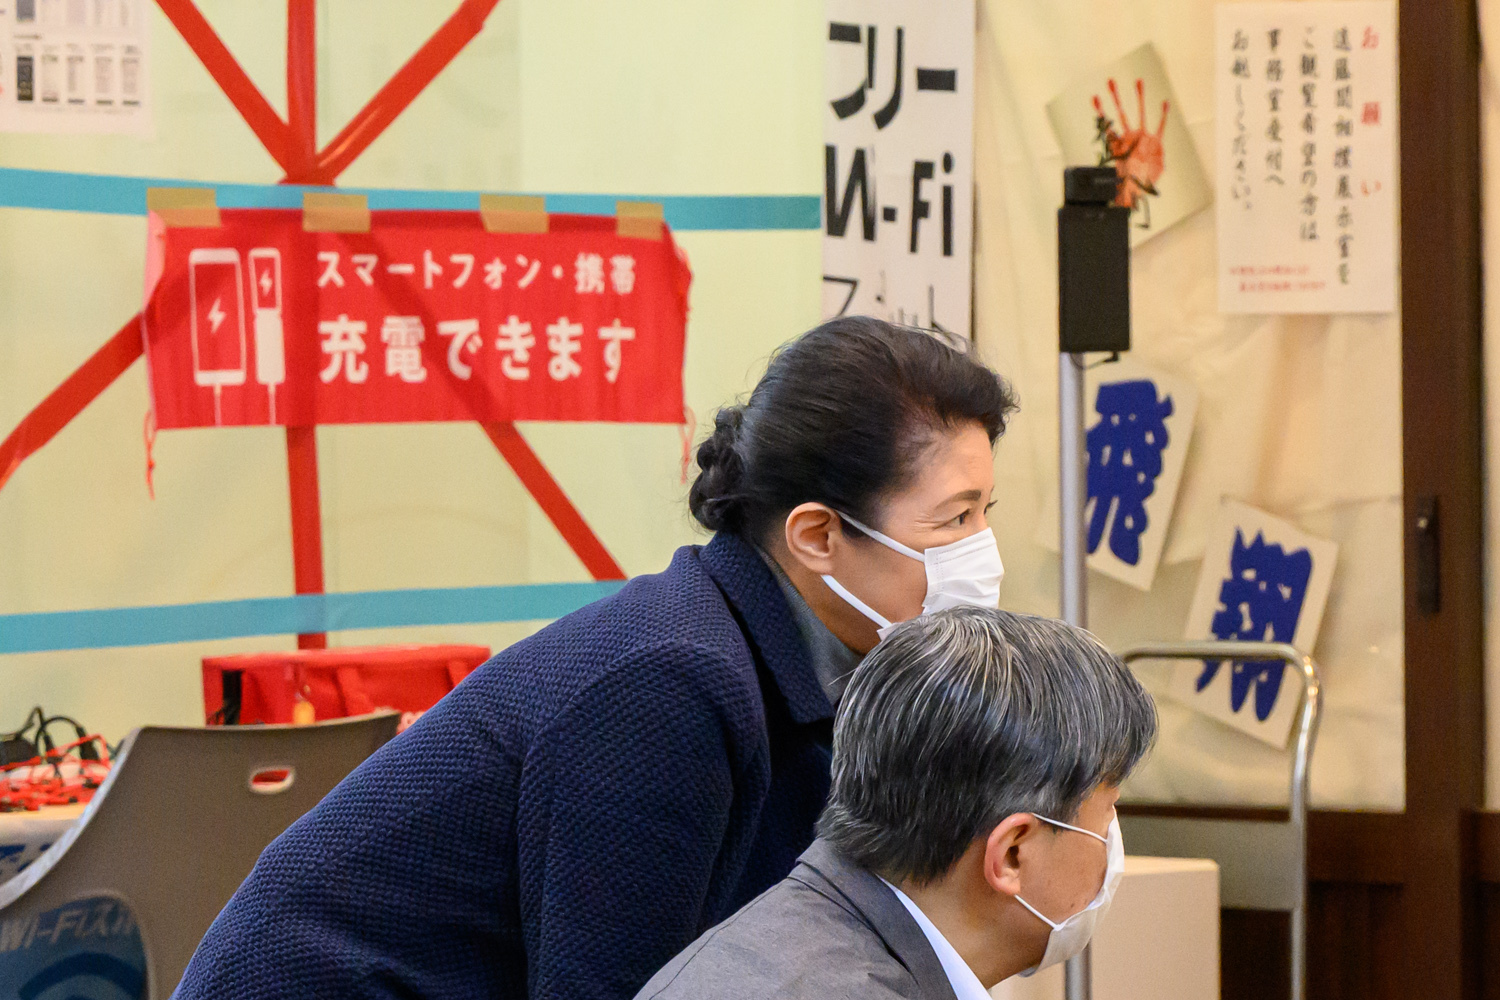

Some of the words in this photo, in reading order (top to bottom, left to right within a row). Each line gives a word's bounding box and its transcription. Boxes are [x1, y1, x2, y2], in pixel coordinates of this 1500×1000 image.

[829, 21, 957, 131] フリー
[317, 313, 637, 384] 充電できます
